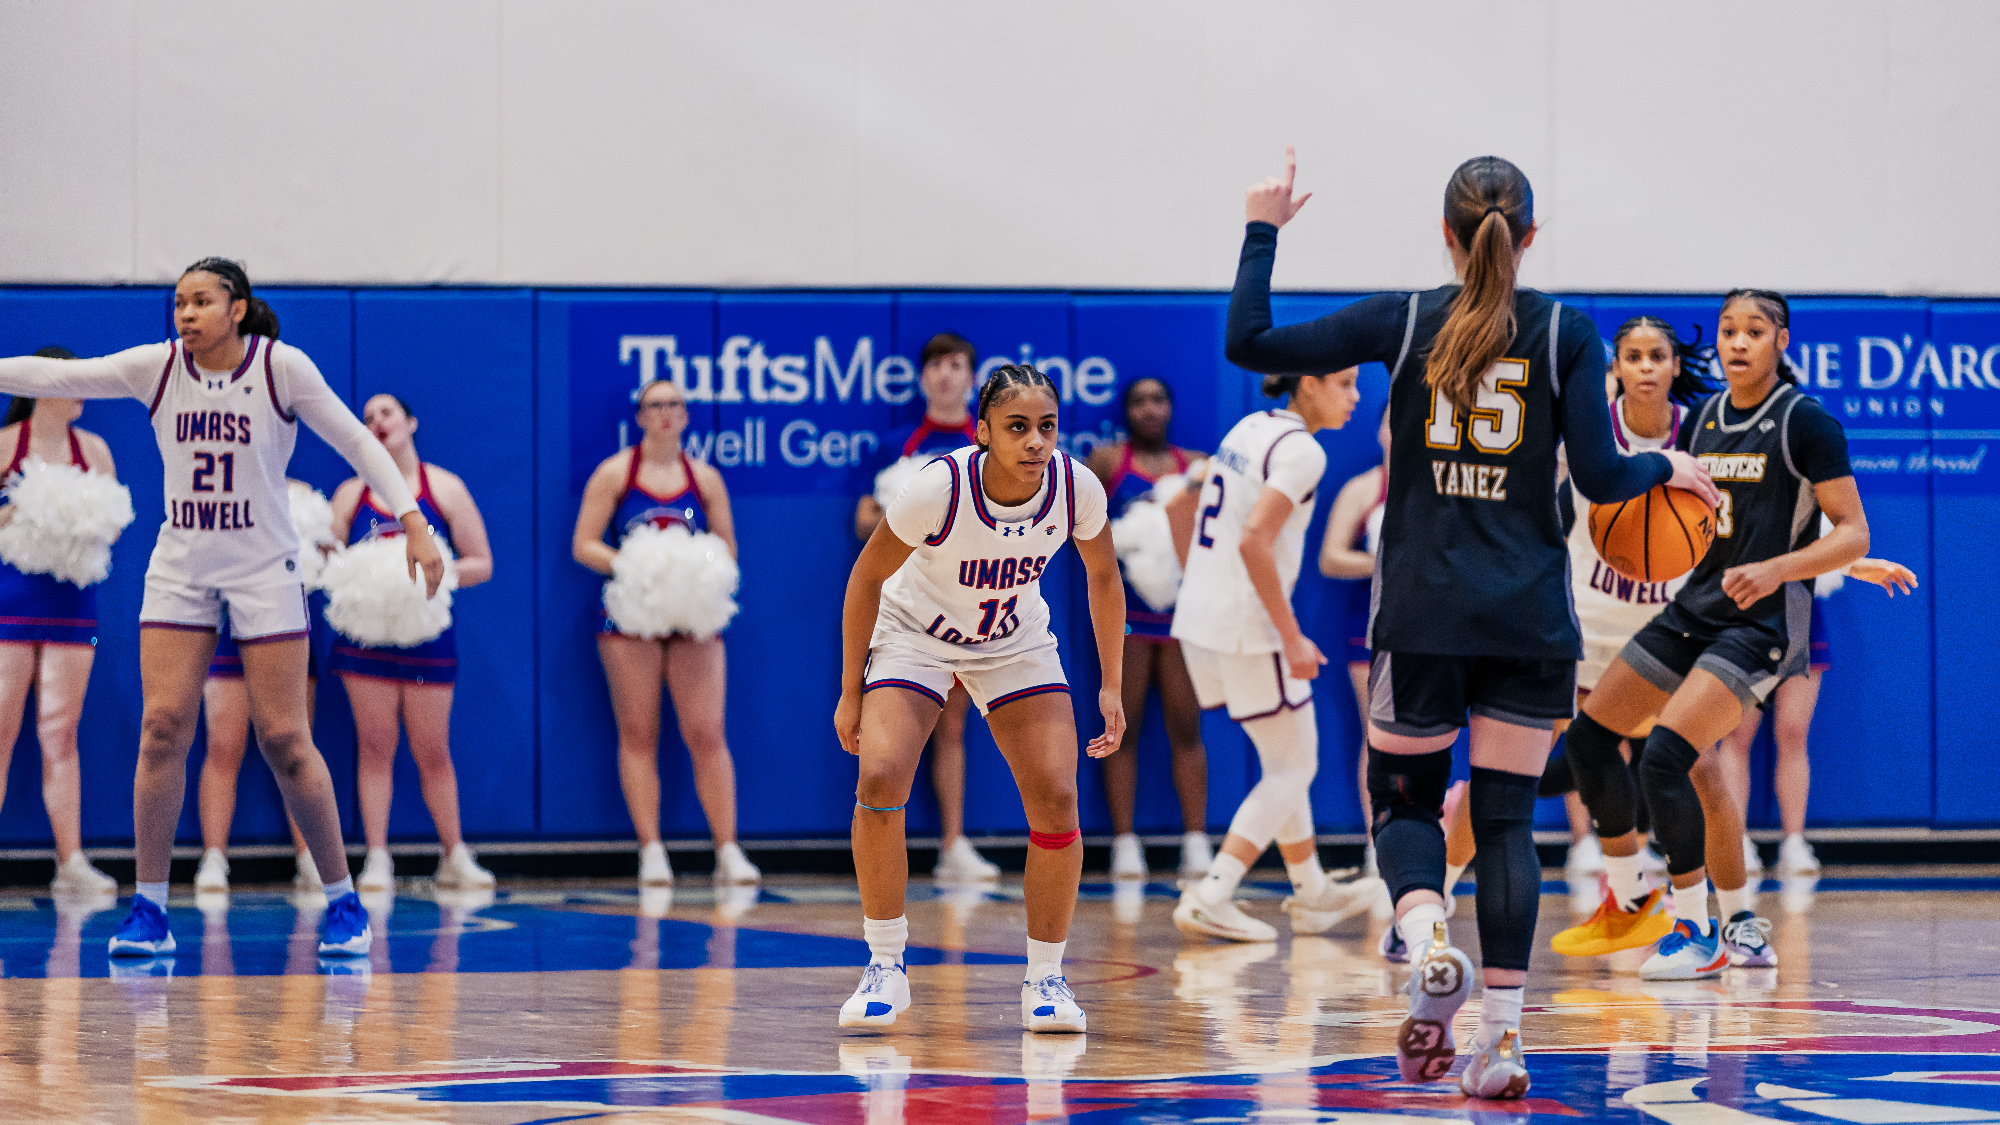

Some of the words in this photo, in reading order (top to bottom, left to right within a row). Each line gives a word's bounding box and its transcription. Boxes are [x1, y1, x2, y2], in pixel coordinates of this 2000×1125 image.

[1425, 356, 1530, 456] 15
[1843, 394, 1946, 419] UNION
[175, 410, 252, 446] UMASS
[192, 450, 235, 494] 21
[1431, 459, 1508, 502] YANEZ
[171, 499, 255, 532] LOWELL
[1198, 473, 1226, 551] 2
[958, 555, 1047, 591] UMASS
[1589, 559, 1673, 605] LOWELL
[977, 594, 1019, 637] 11
